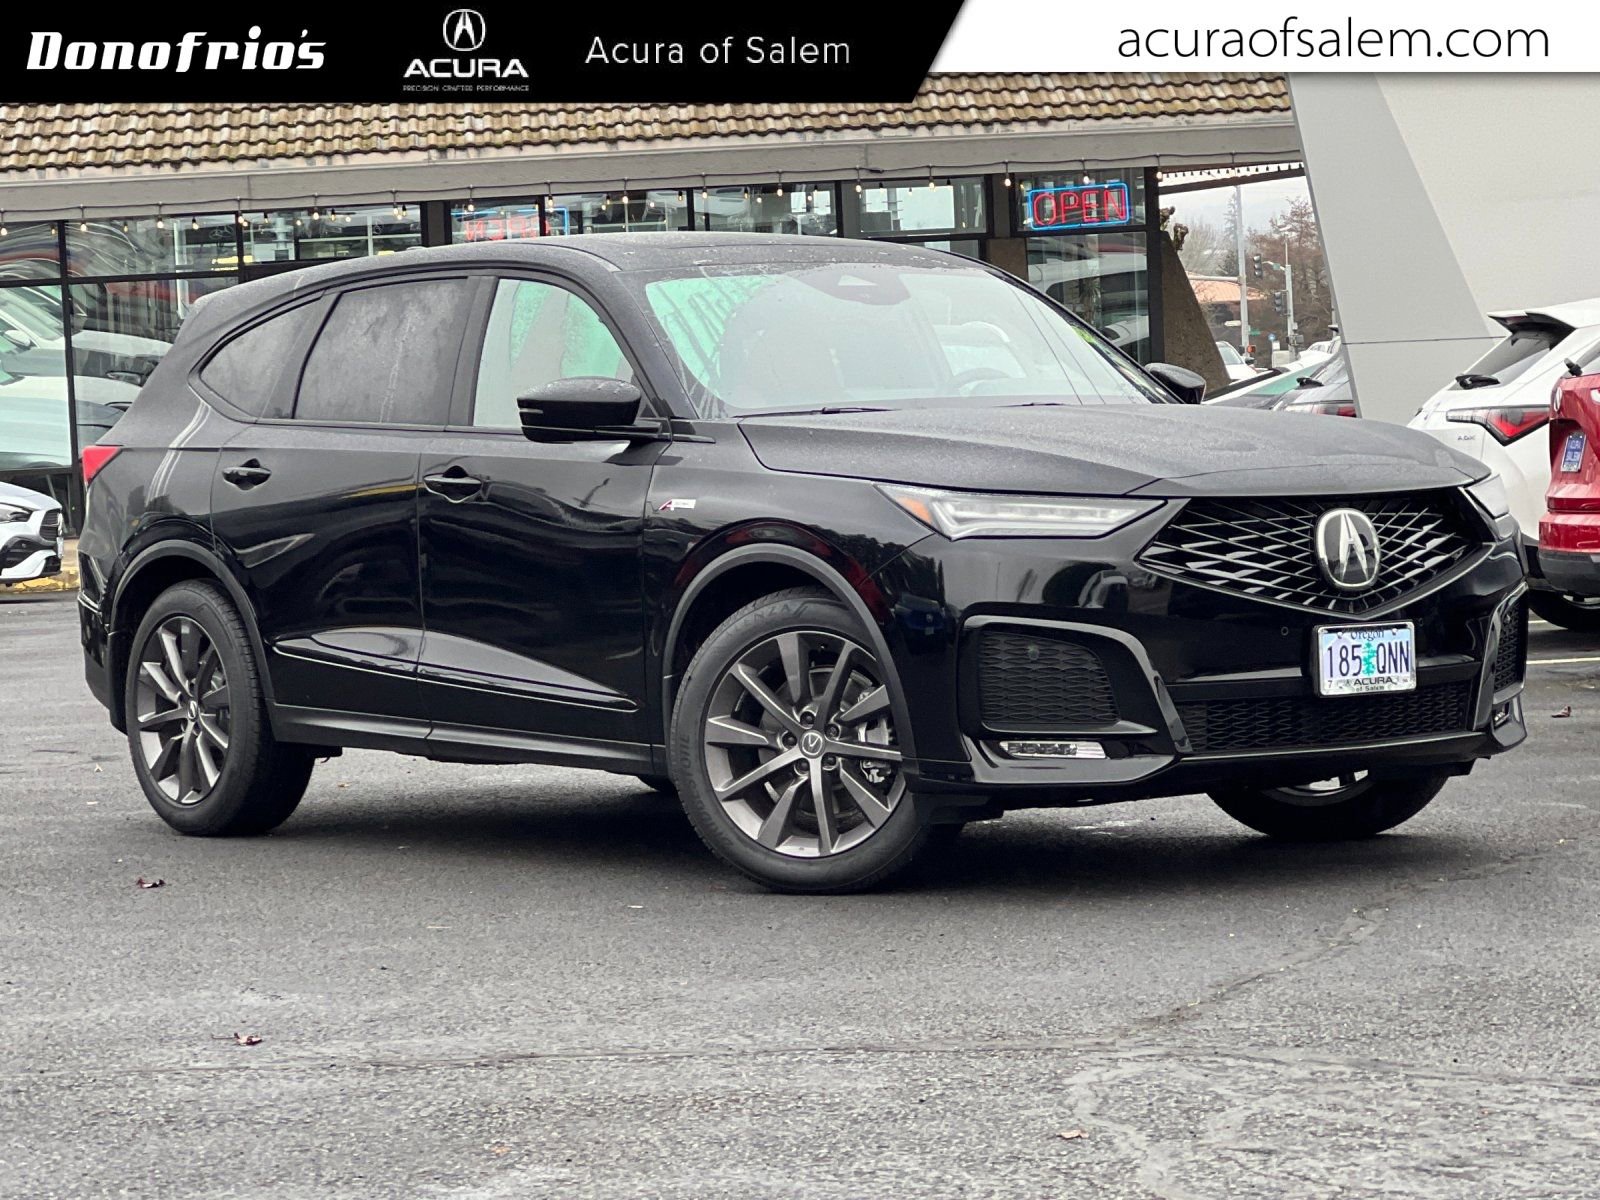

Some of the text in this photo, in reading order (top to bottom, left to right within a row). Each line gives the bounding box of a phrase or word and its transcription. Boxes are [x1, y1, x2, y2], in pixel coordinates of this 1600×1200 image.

[1033, 188, 1126, 226] OPEN
[1327, 641, 1410, 678] 185 QNN
[1353, 676, 1395, 686] ACURA
